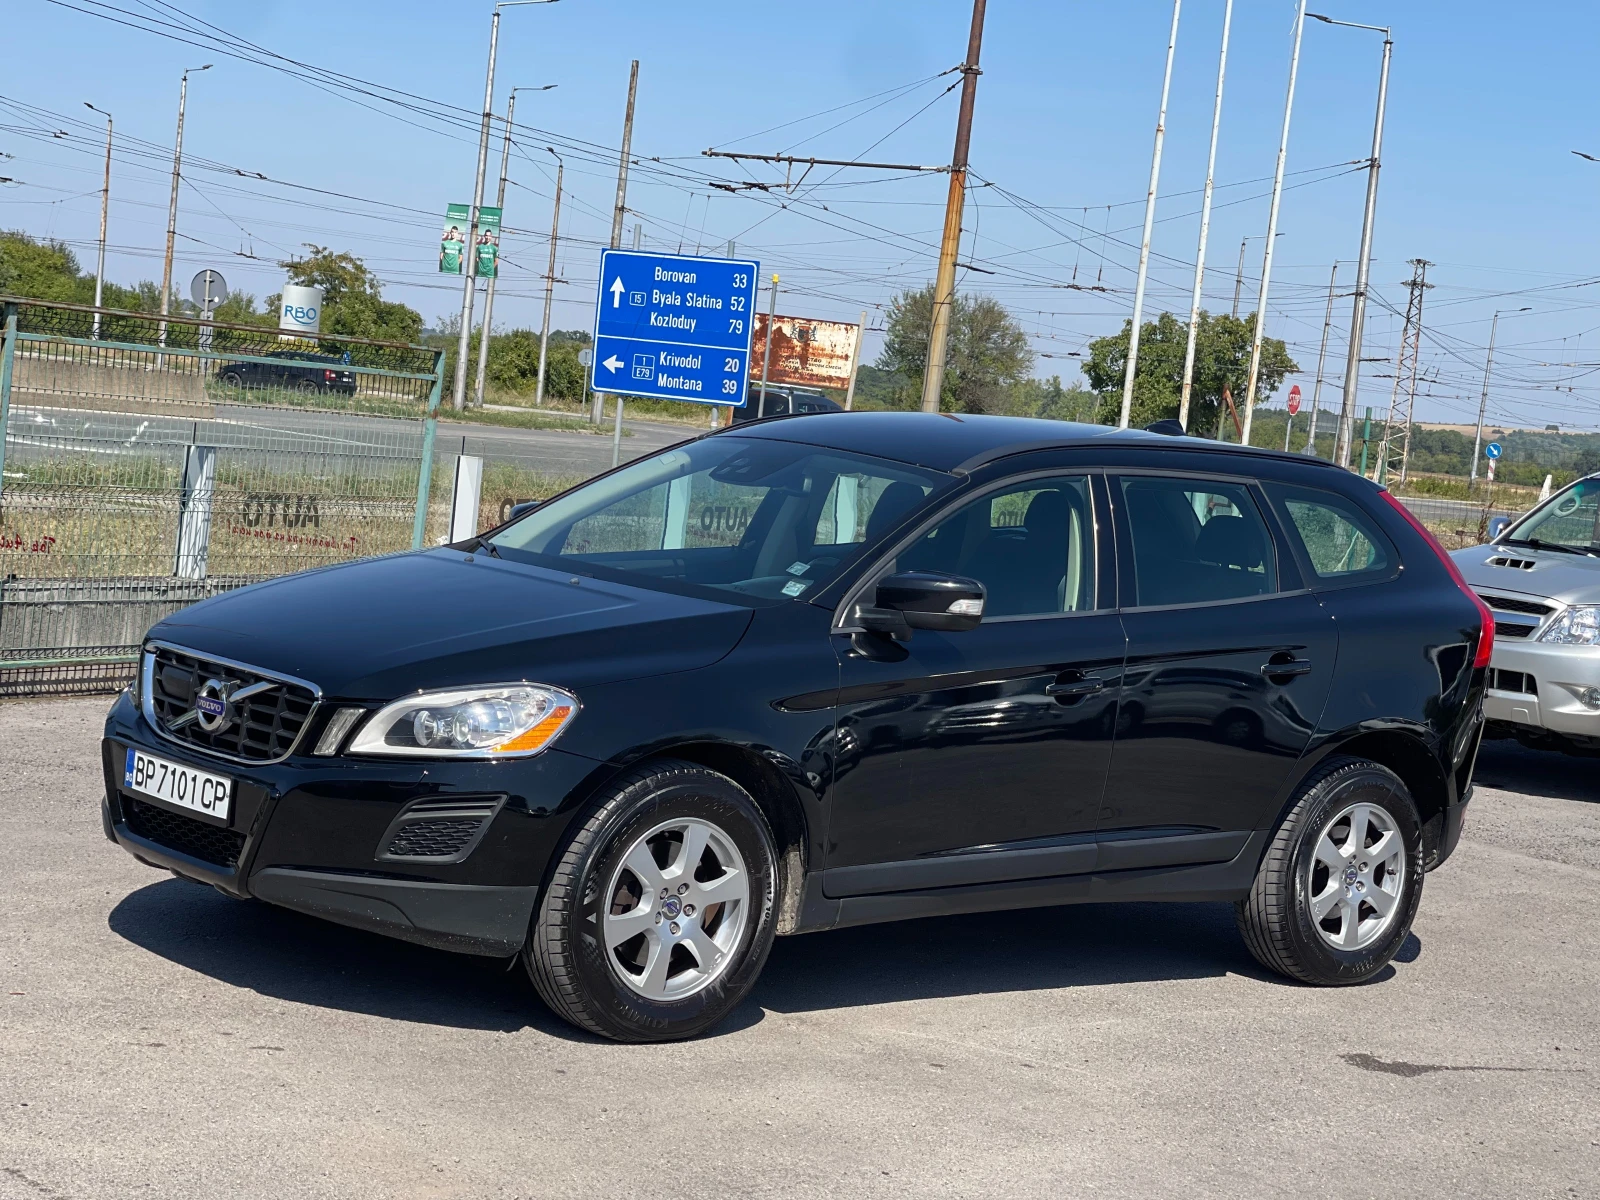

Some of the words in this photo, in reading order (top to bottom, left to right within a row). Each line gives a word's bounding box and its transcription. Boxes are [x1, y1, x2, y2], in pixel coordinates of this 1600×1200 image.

[655, 267, 696, 284] Borovan
[733, 274, 747, 288] 33
[634, 294, 642, 303] 15
[652, 290, 681, 307] Byala
[686, 292, 722, 309] Slatina
[730, 297, 745, 311] 52
[284, 305, 317, 322] RBO
[650, 312, 696, 333] Kozloduy
[728, 319, 743, 334] 79
[659, 352, 701, 369] Krivodol
[724, 358, 739, 372] 20
[636, 368, 649, 378] E79
[658, 373, 702, 390] Montana
[722, 379, 737, 394] 39
[198, 698, 222, 712] VOLVO
[157, 764, 198, 805] 7101
